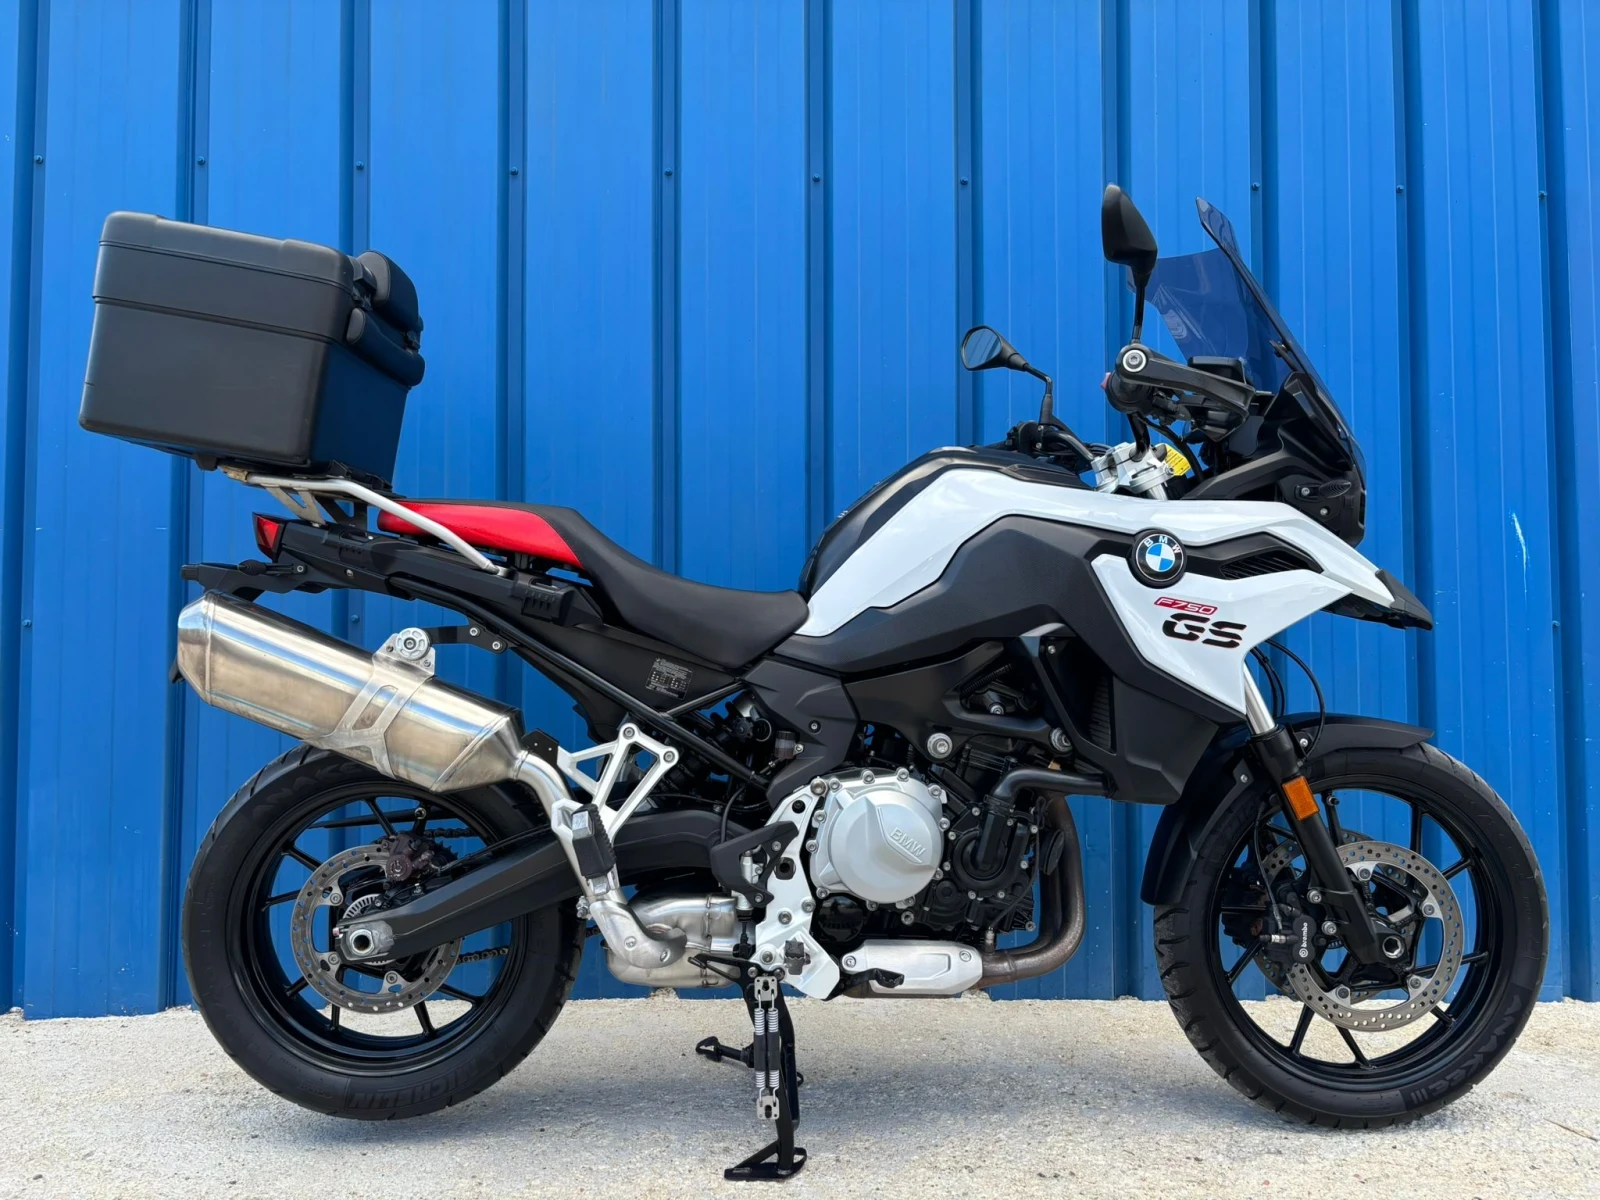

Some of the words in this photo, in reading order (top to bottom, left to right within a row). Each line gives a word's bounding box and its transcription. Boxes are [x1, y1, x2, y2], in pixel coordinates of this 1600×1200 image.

[1144, 535, 1181, 554] BMW
[1156, 597, 1215, 614] F750
[1162, 613, 1247, 648] GS
[890, 826, 926, 858] BMW
